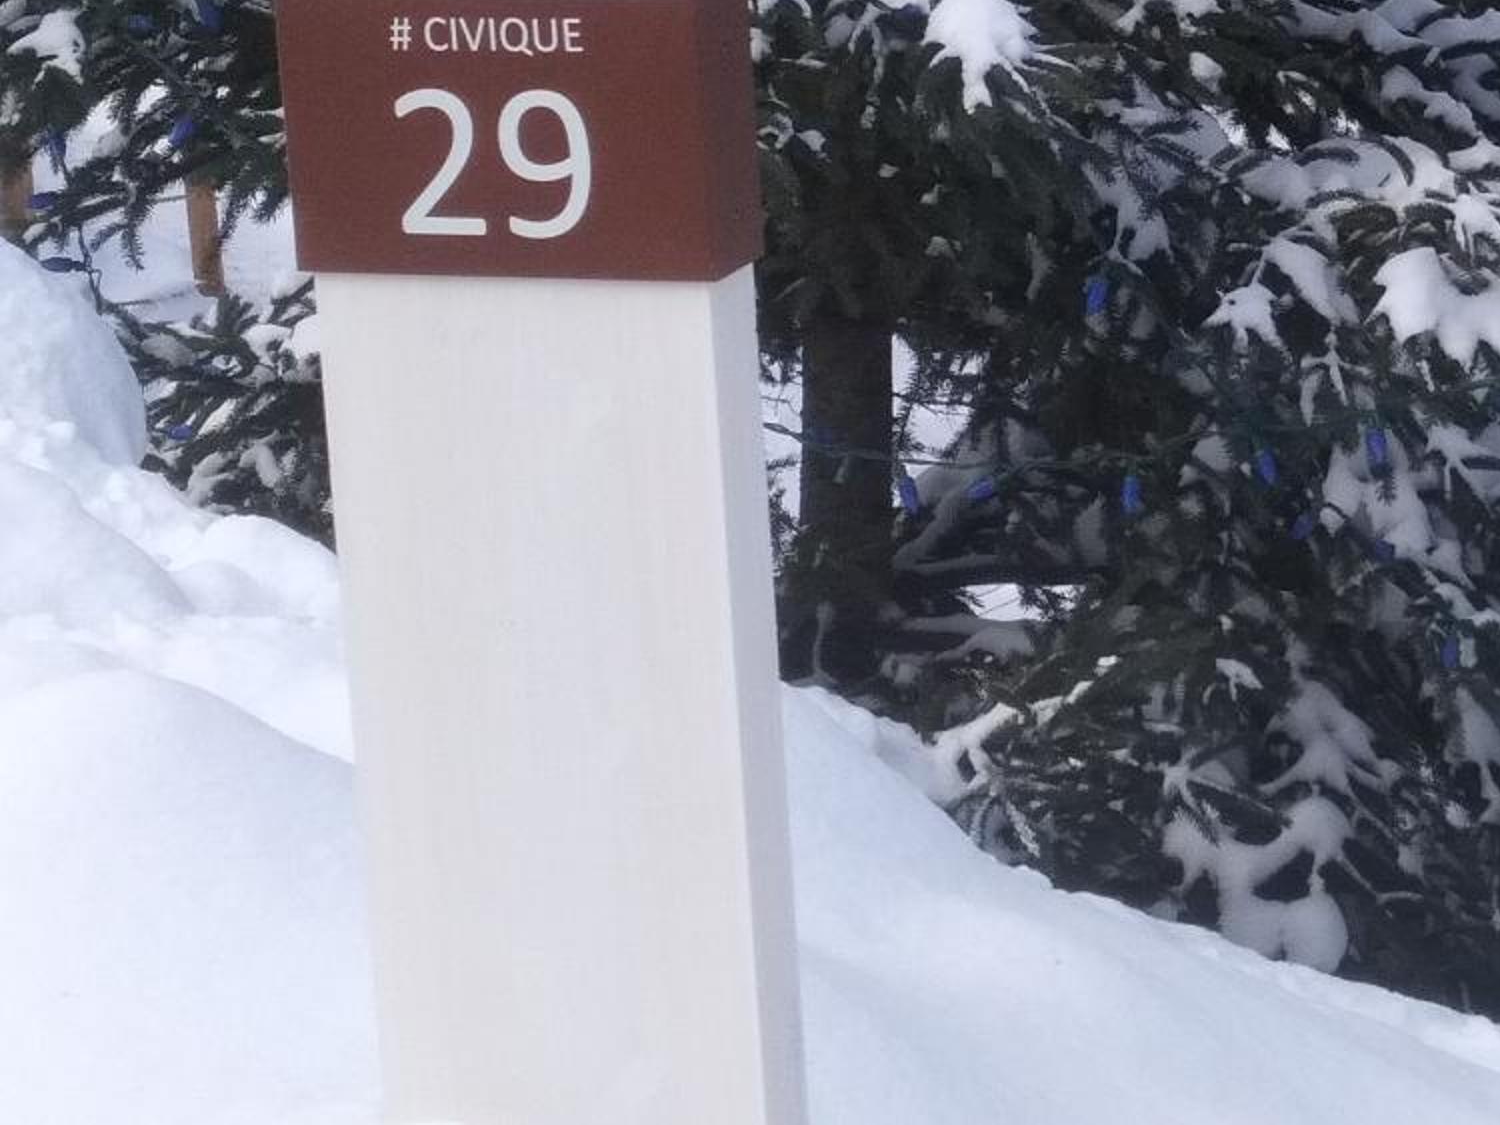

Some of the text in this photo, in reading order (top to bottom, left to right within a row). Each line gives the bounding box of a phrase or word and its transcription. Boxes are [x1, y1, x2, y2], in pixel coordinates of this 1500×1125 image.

[389, 16, 585, 56] # CIVIQUE
[394, 88, 592, 240] 29
